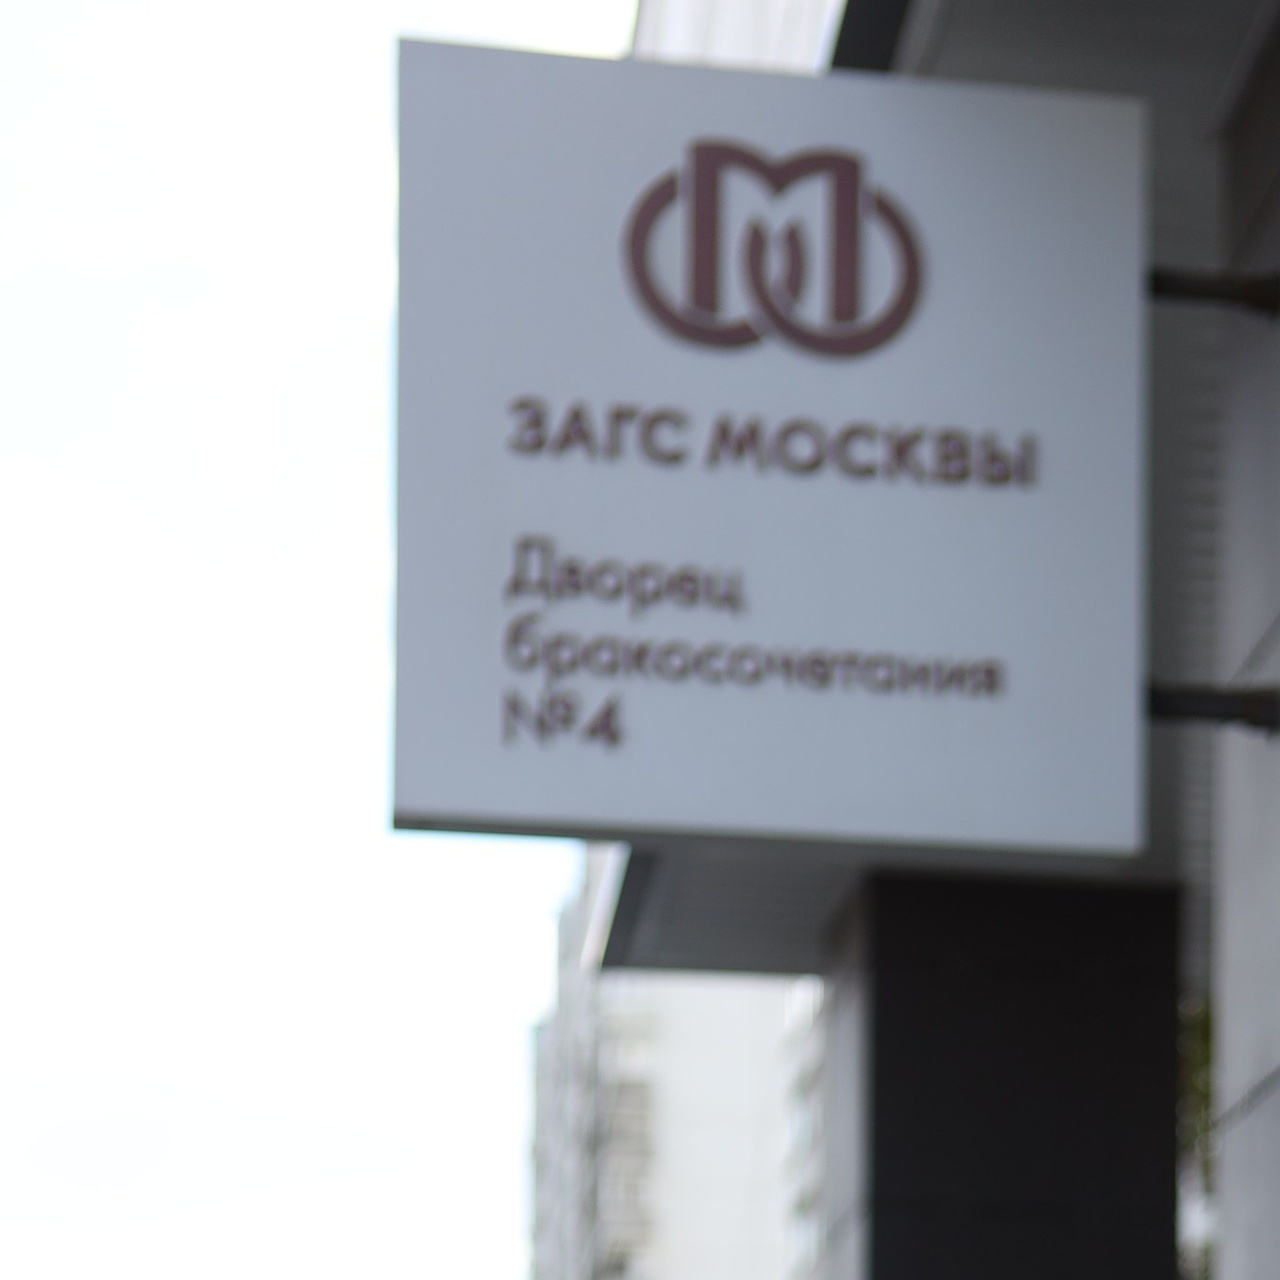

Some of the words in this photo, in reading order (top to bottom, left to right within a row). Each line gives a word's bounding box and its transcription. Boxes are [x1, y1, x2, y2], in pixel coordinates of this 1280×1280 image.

[507, 395, 692, 468] ЗАГС
[703, 408, 1043, 490] МОСКВЫ
[503, 533, 749, 622] Дворец
[503, 611, 1005, 698] бракосочетания
